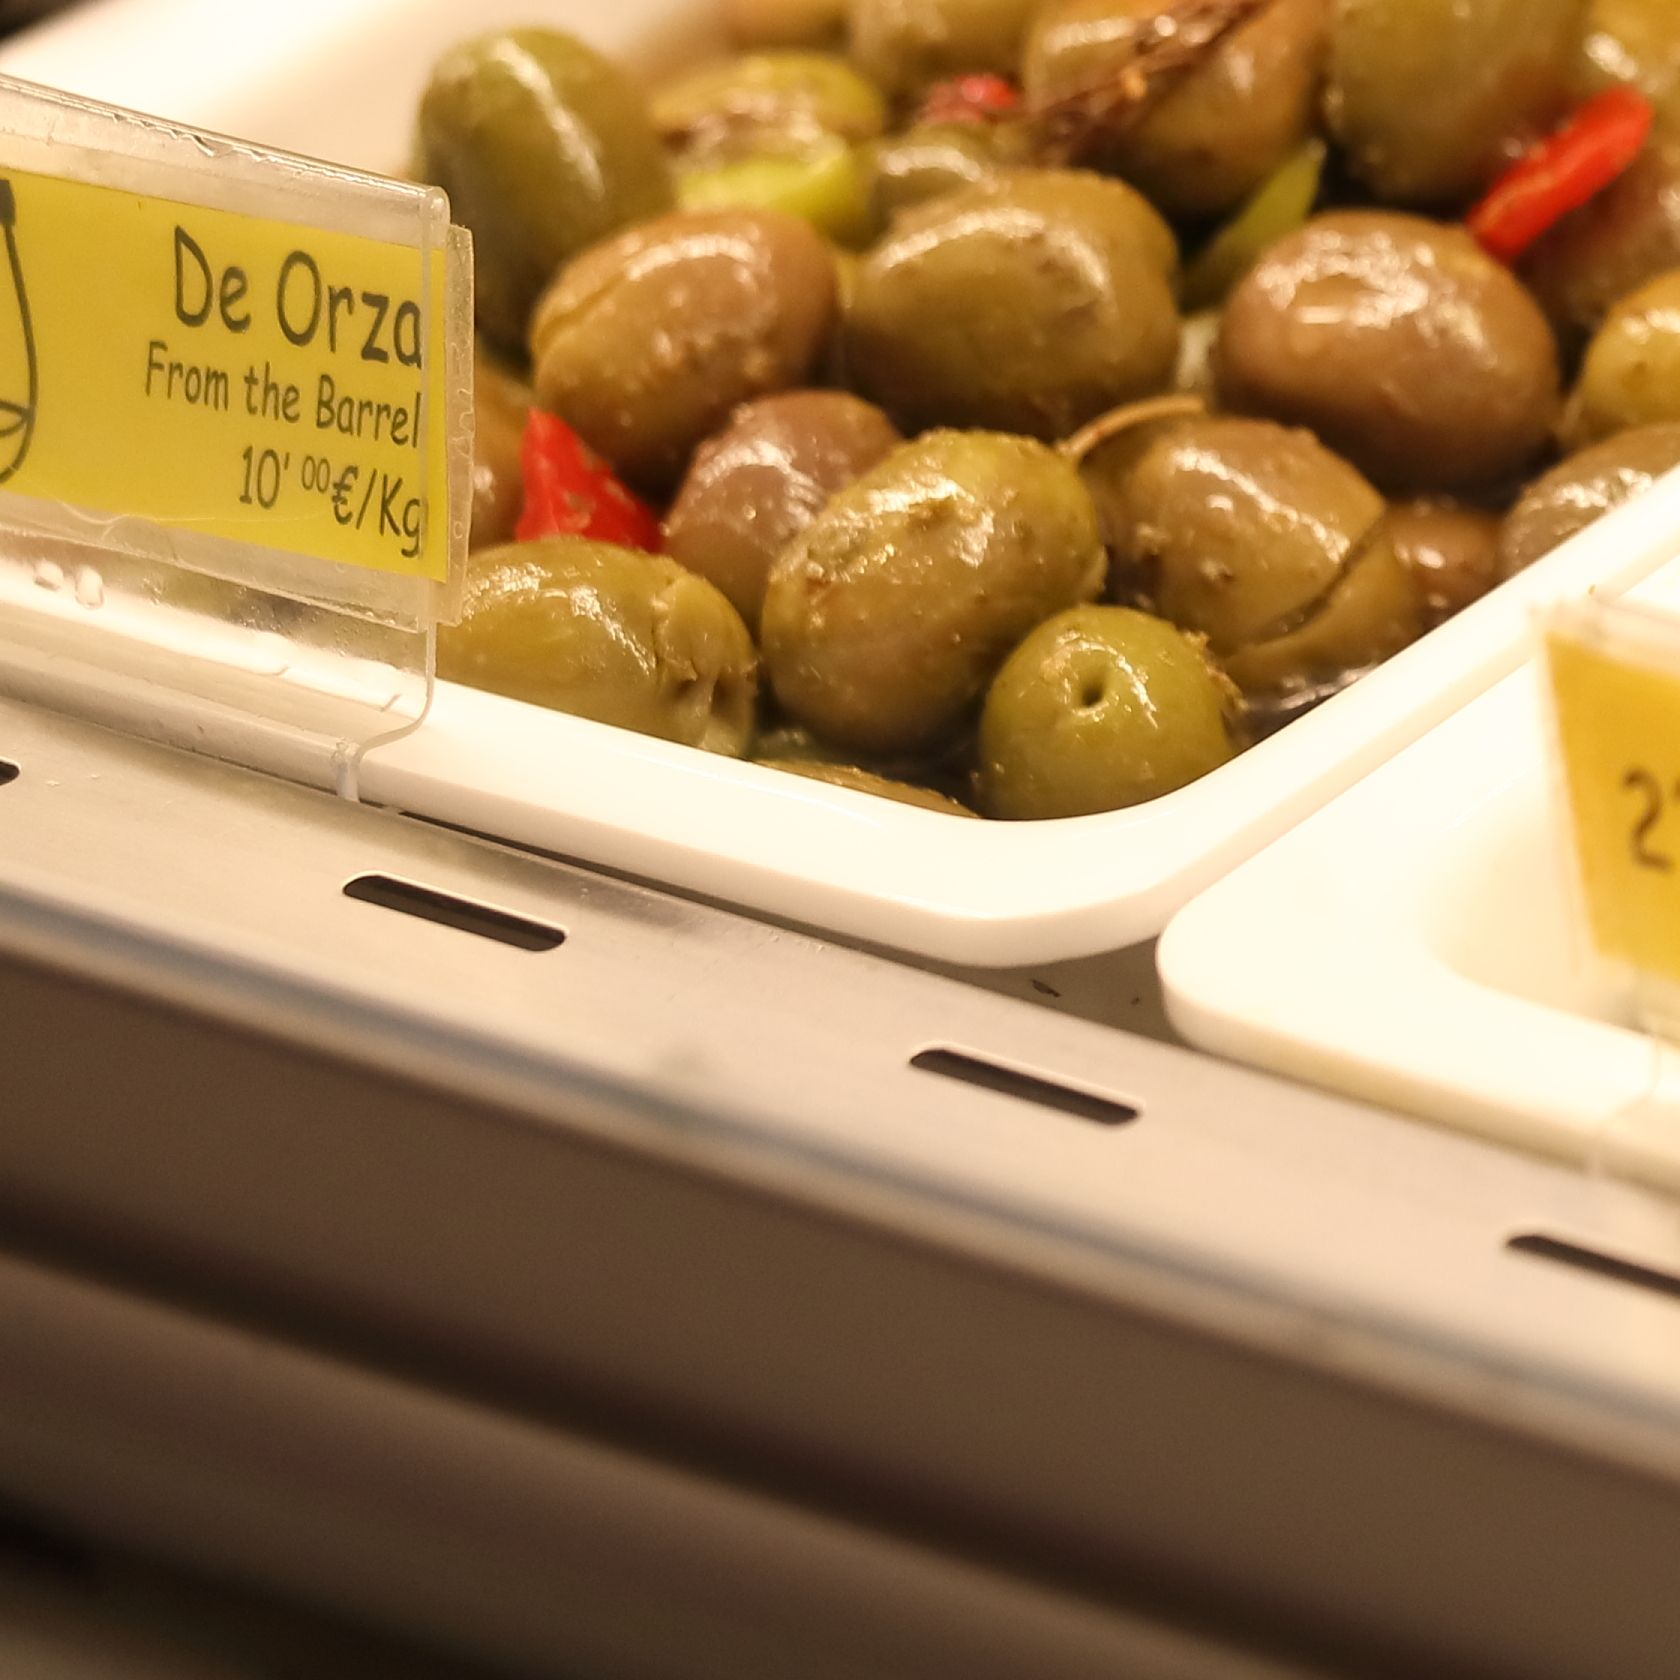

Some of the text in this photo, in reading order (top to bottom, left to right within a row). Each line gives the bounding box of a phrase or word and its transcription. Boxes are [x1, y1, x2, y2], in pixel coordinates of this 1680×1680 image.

[174, 224, 422, 369] De Orza
[145, 339, 422, 449] From the Barrel
